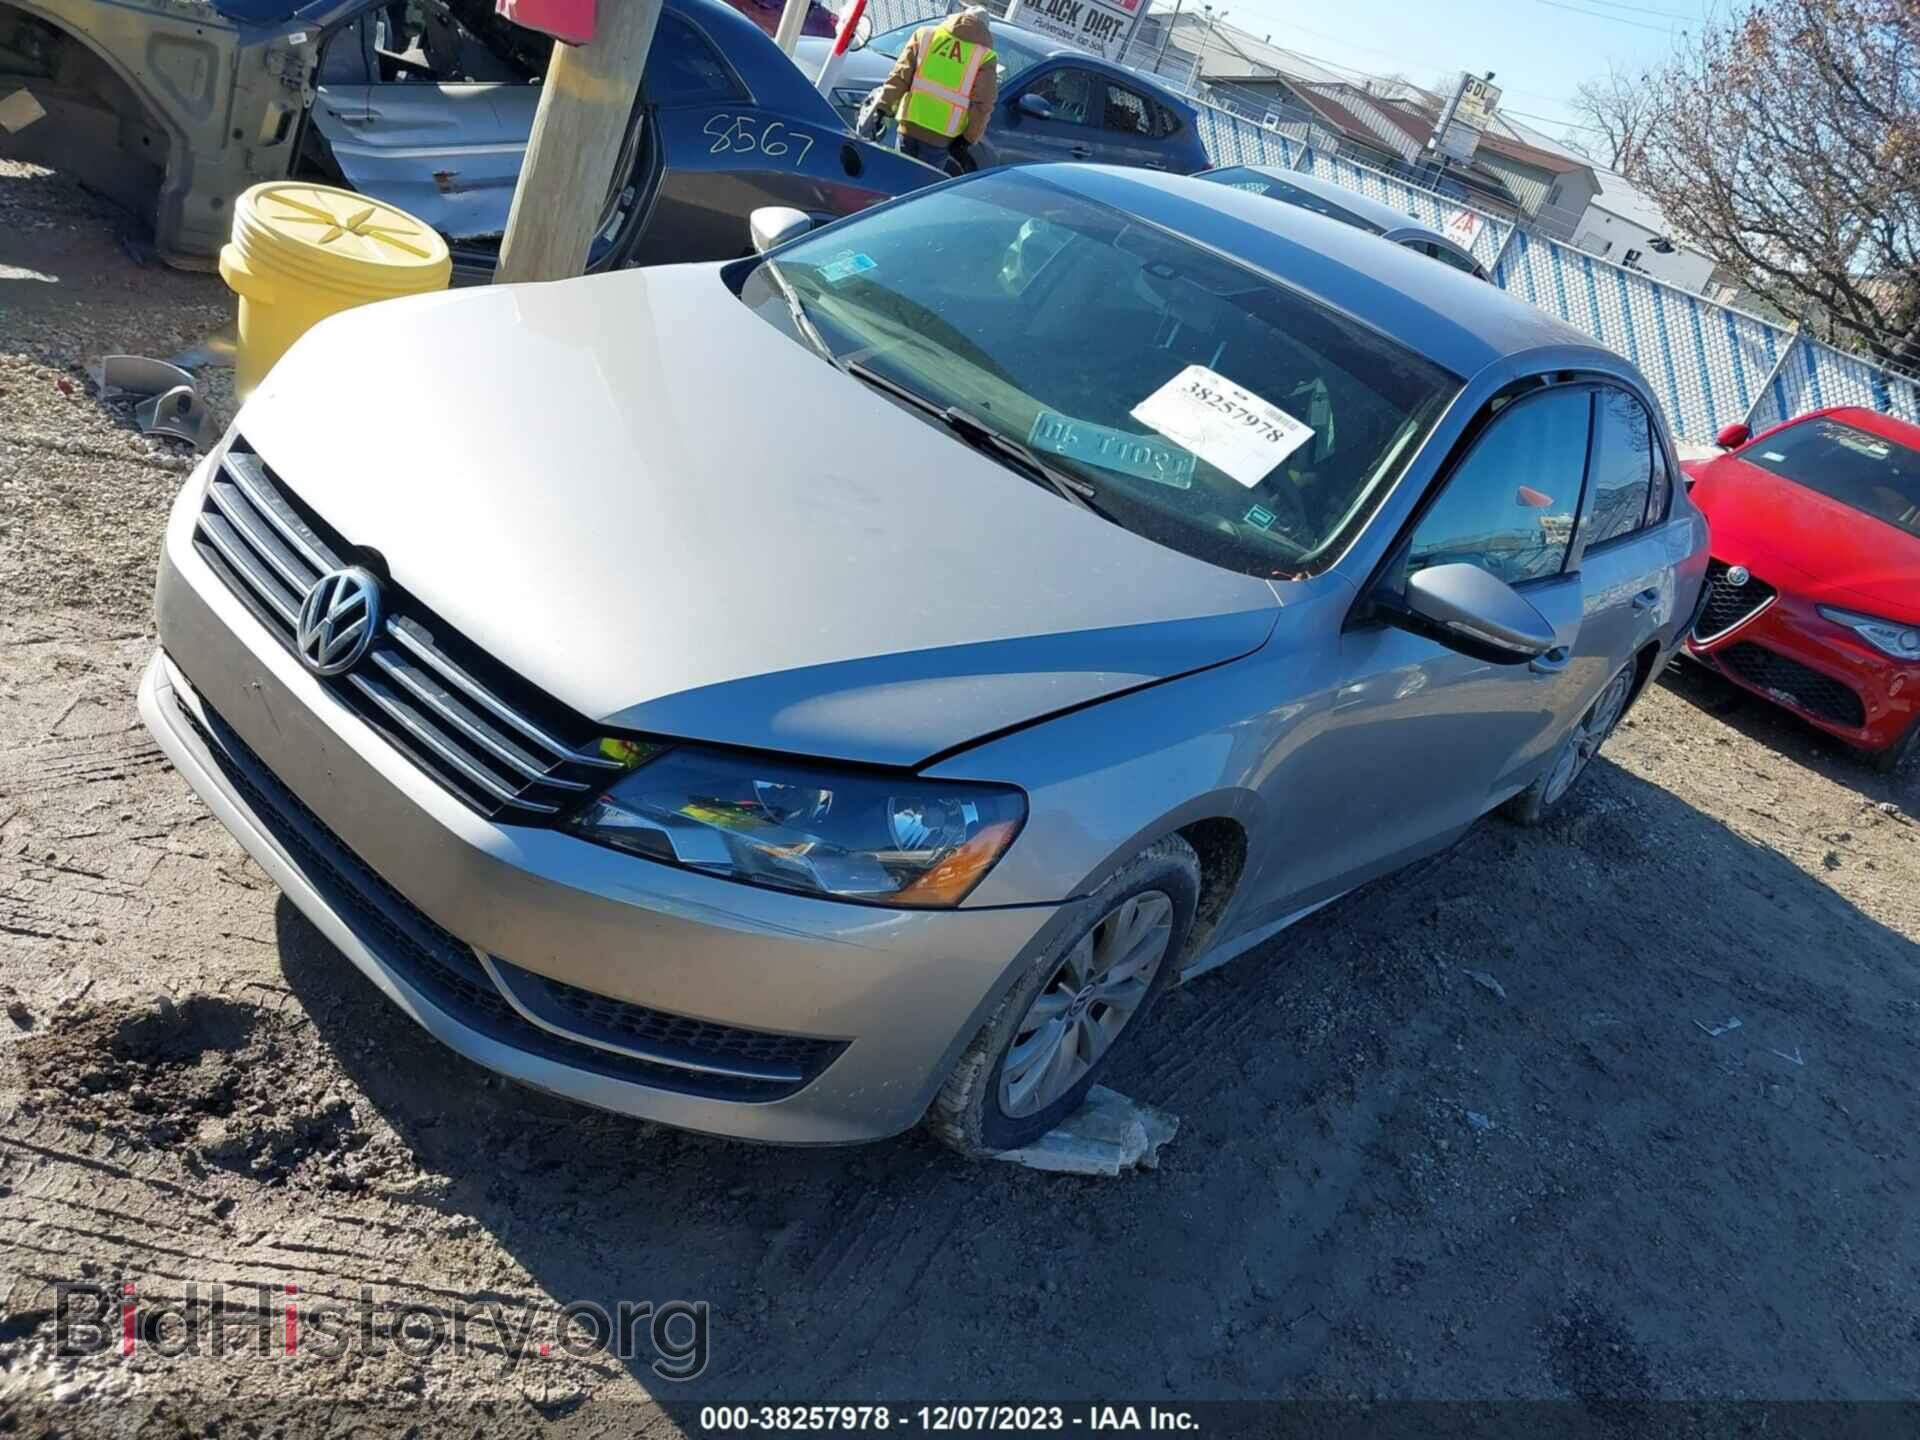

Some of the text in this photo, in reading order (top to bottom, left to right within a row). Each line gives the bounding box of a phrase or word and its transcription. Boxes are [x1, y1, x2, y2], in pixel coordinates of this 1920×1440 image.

[1082, 8, 1125, 43] DIRT
[1465, 78, 1488, 101] GDL
[703, 113, 815, 167] 8567
[1182, 381, 1286, 443] 38257978
